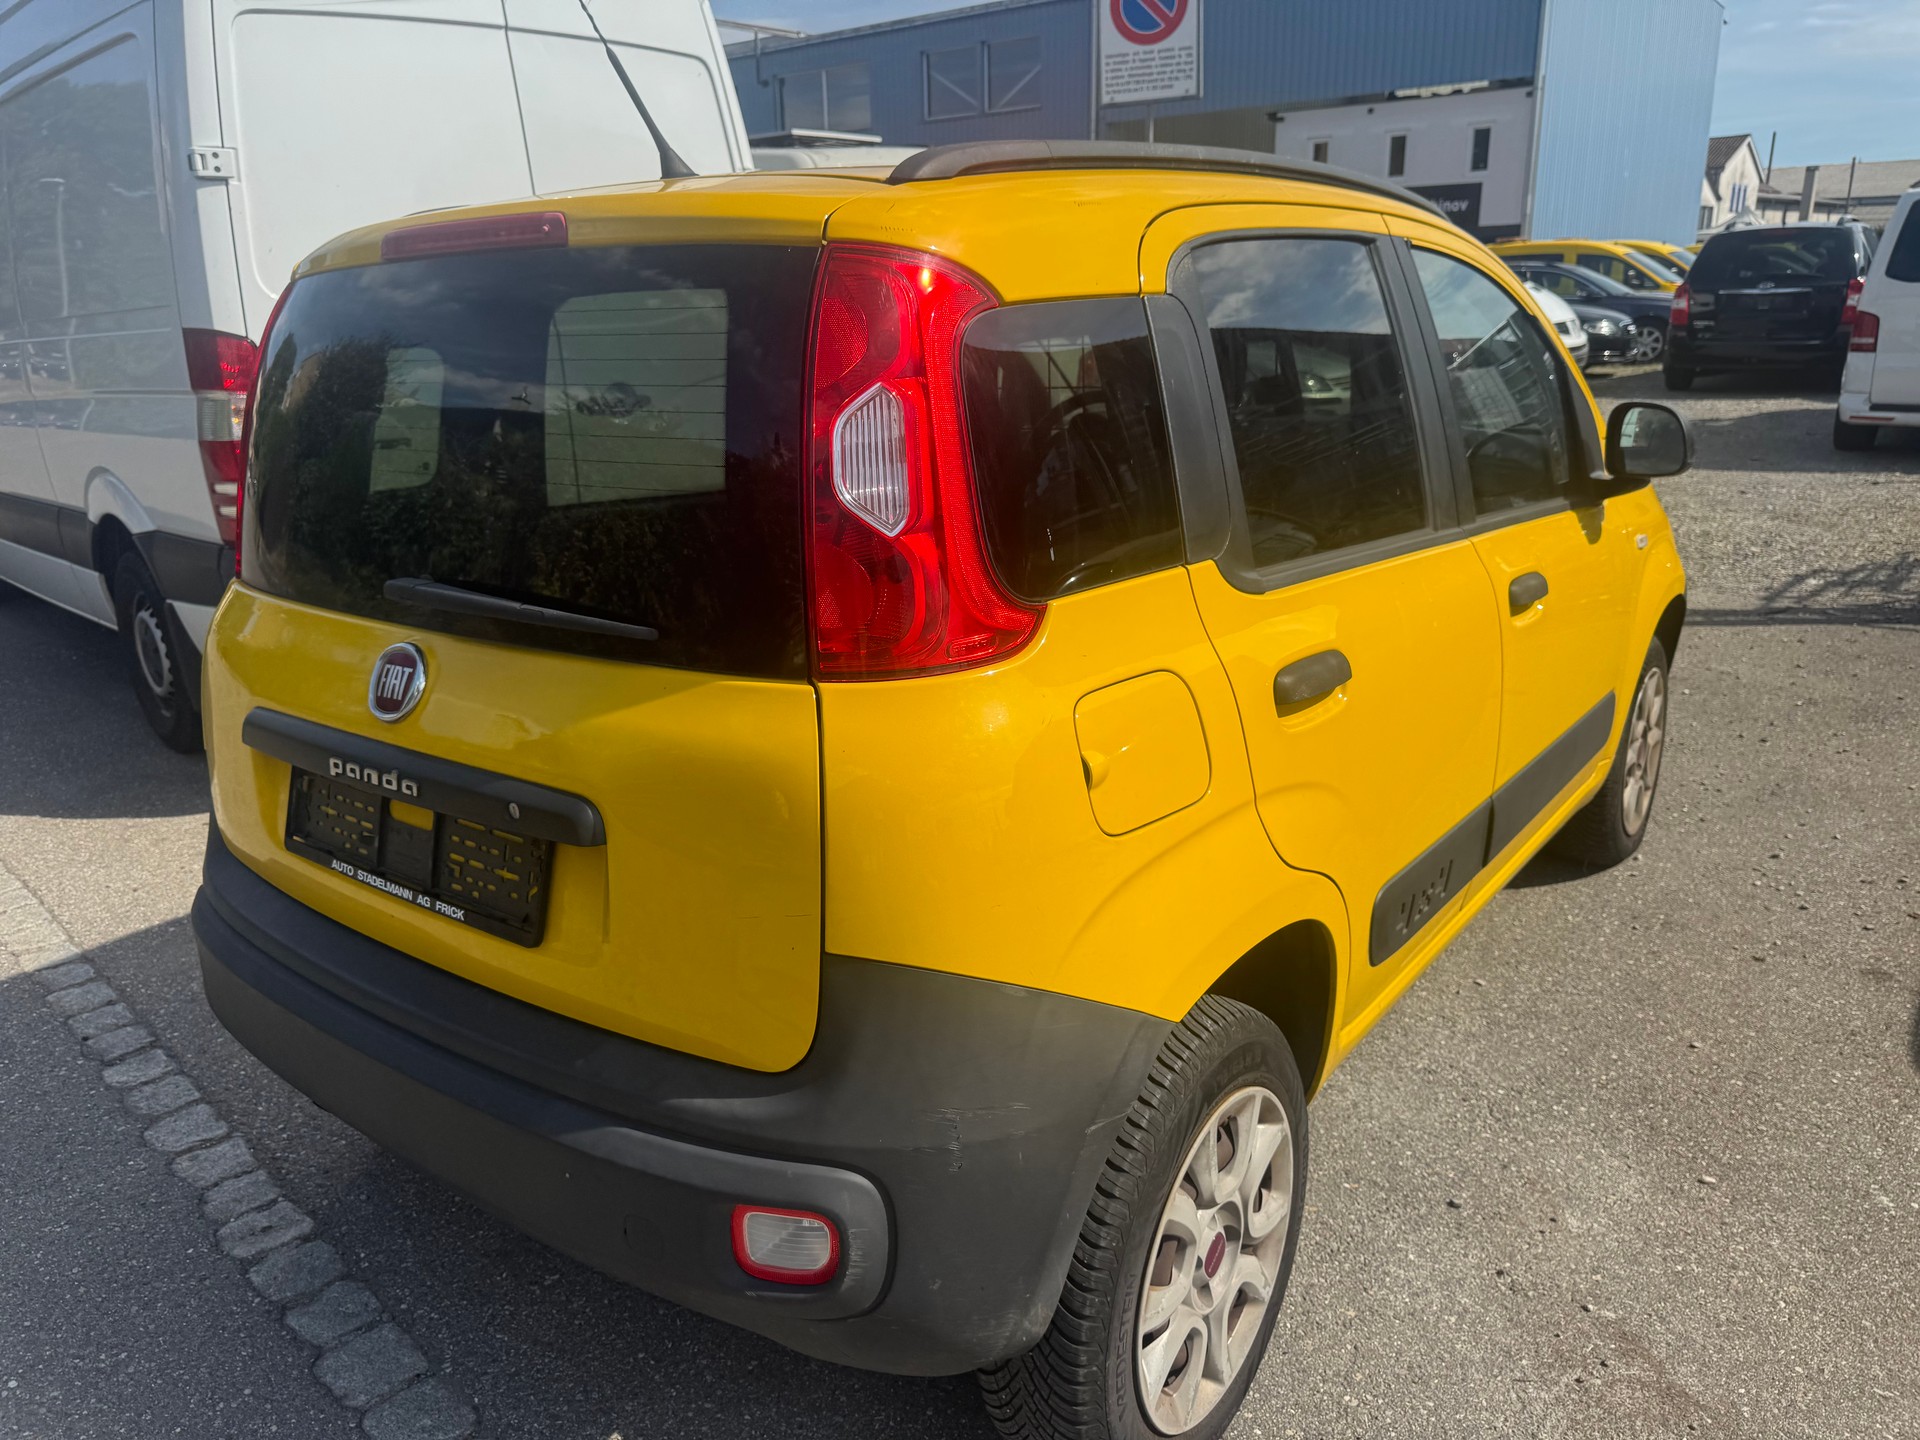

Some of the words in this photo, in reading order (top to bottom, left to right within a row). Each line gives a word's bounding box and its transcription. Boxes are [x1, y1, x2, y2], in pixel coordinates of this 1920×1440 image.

[377, 663, 414, 701] FIAT
[329, 757, 418, 797] panda
[331, 859, 354, 876] AUTO
[357, 870, 413, 900] STADELMANN
[416, 894, 431, 908] AG
[435, 901, 464, 921] FRICK
